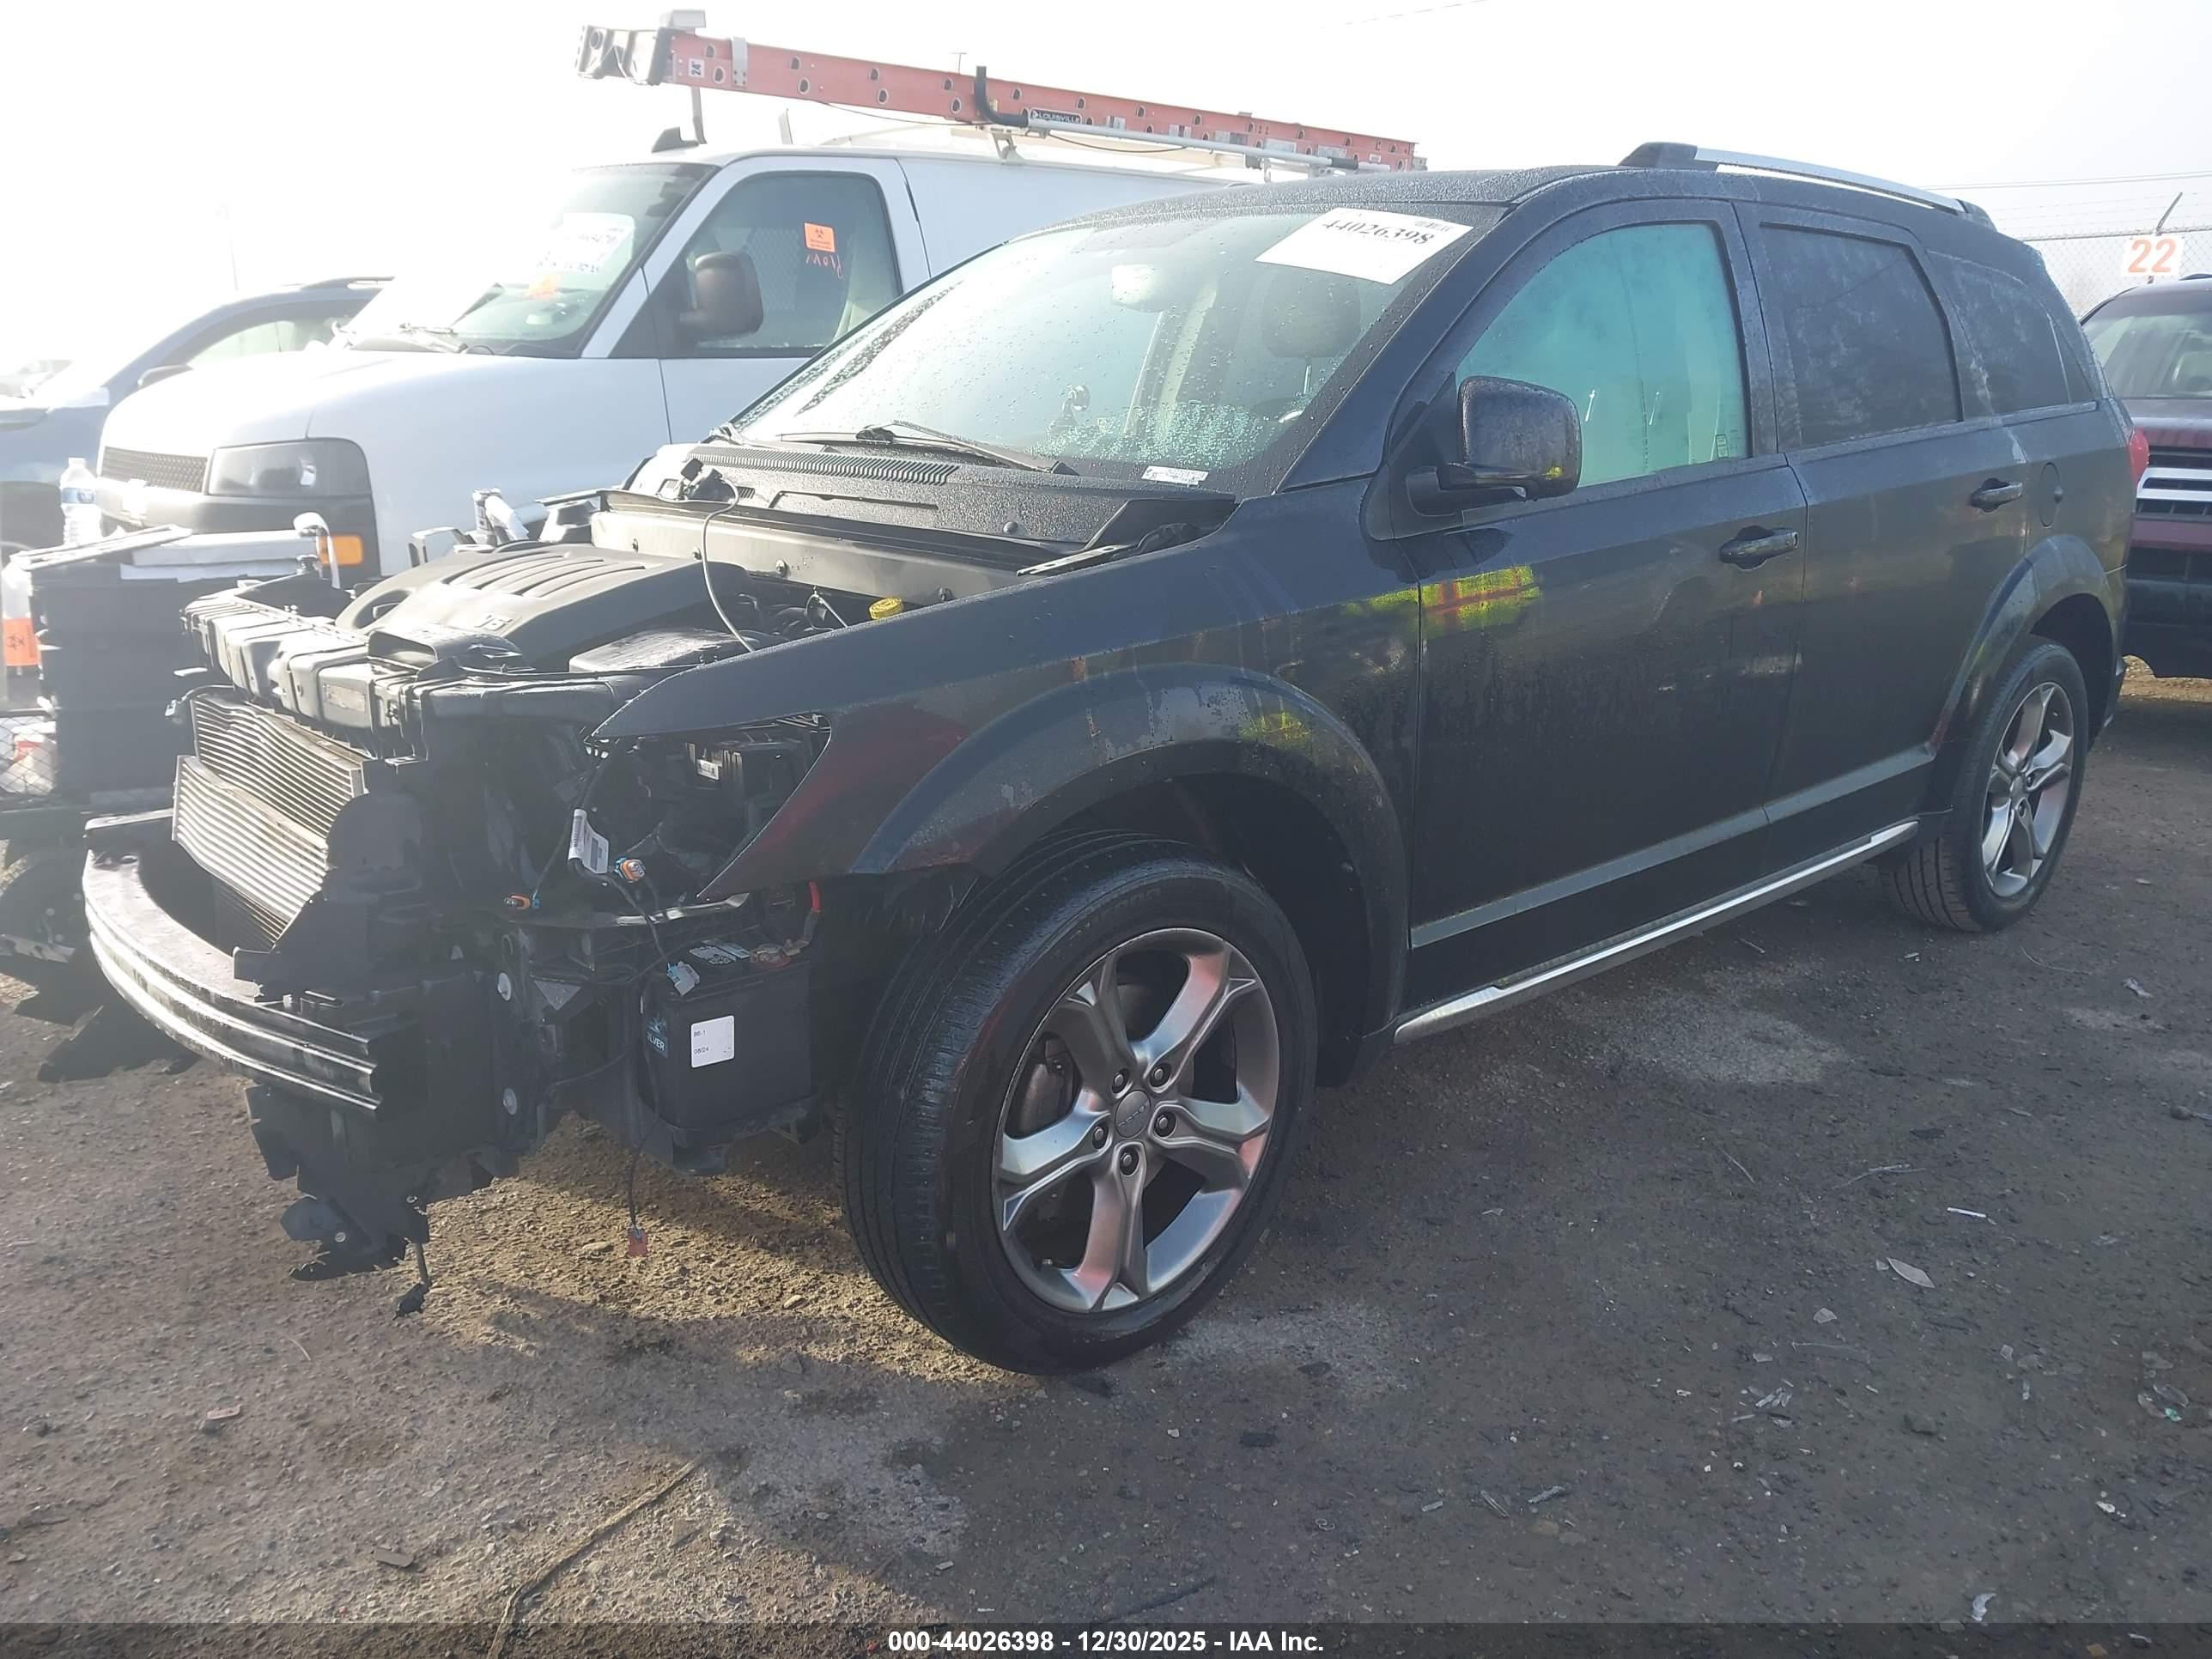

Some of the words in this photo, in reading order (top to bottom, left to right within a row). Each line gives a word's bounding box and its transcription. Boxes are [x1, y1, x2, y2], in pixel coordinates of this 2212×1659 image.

[1039, 112, 1080, 124] LOUISVILLE
[1322, 219, 1435, 245] 44026398
[2128, 238, 2176, 273] 22
